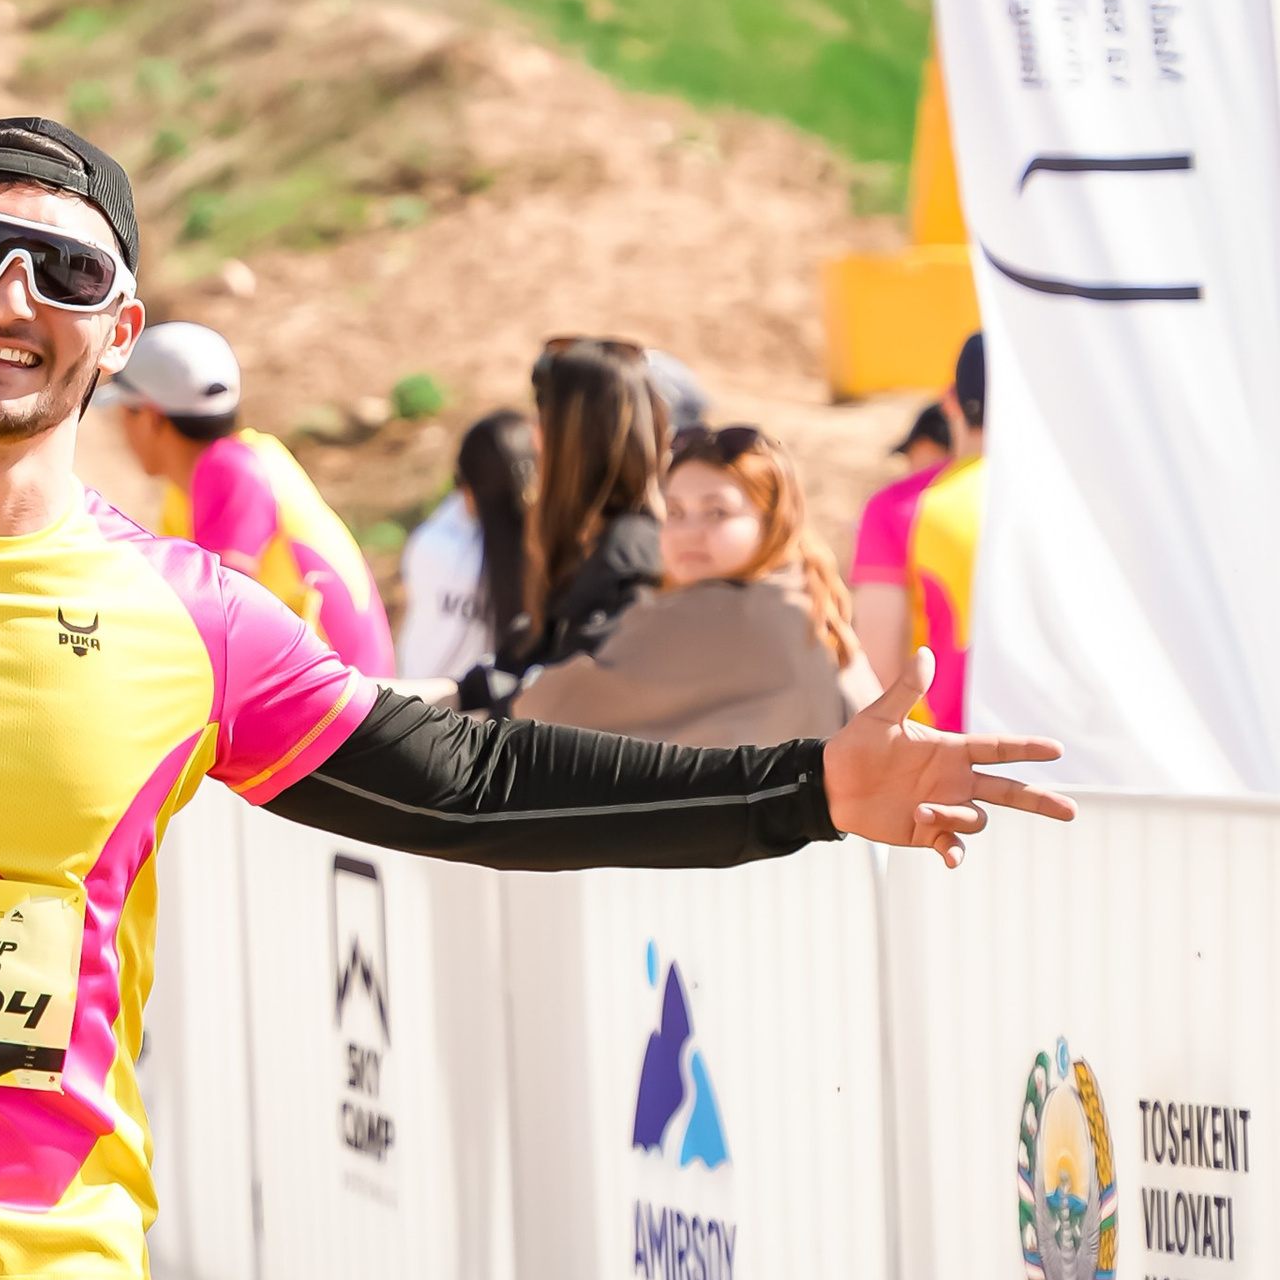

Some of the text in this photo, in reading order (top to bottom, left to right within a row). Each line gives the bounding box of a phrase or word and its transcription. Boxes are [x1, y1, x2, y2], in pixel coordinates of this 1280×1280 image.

[58, 632, 101, 651] BUKA
[1139, 1097, 1251, 1173] TOSHKENT
[1141, 1187, 1235, 1262] VILOYATI
